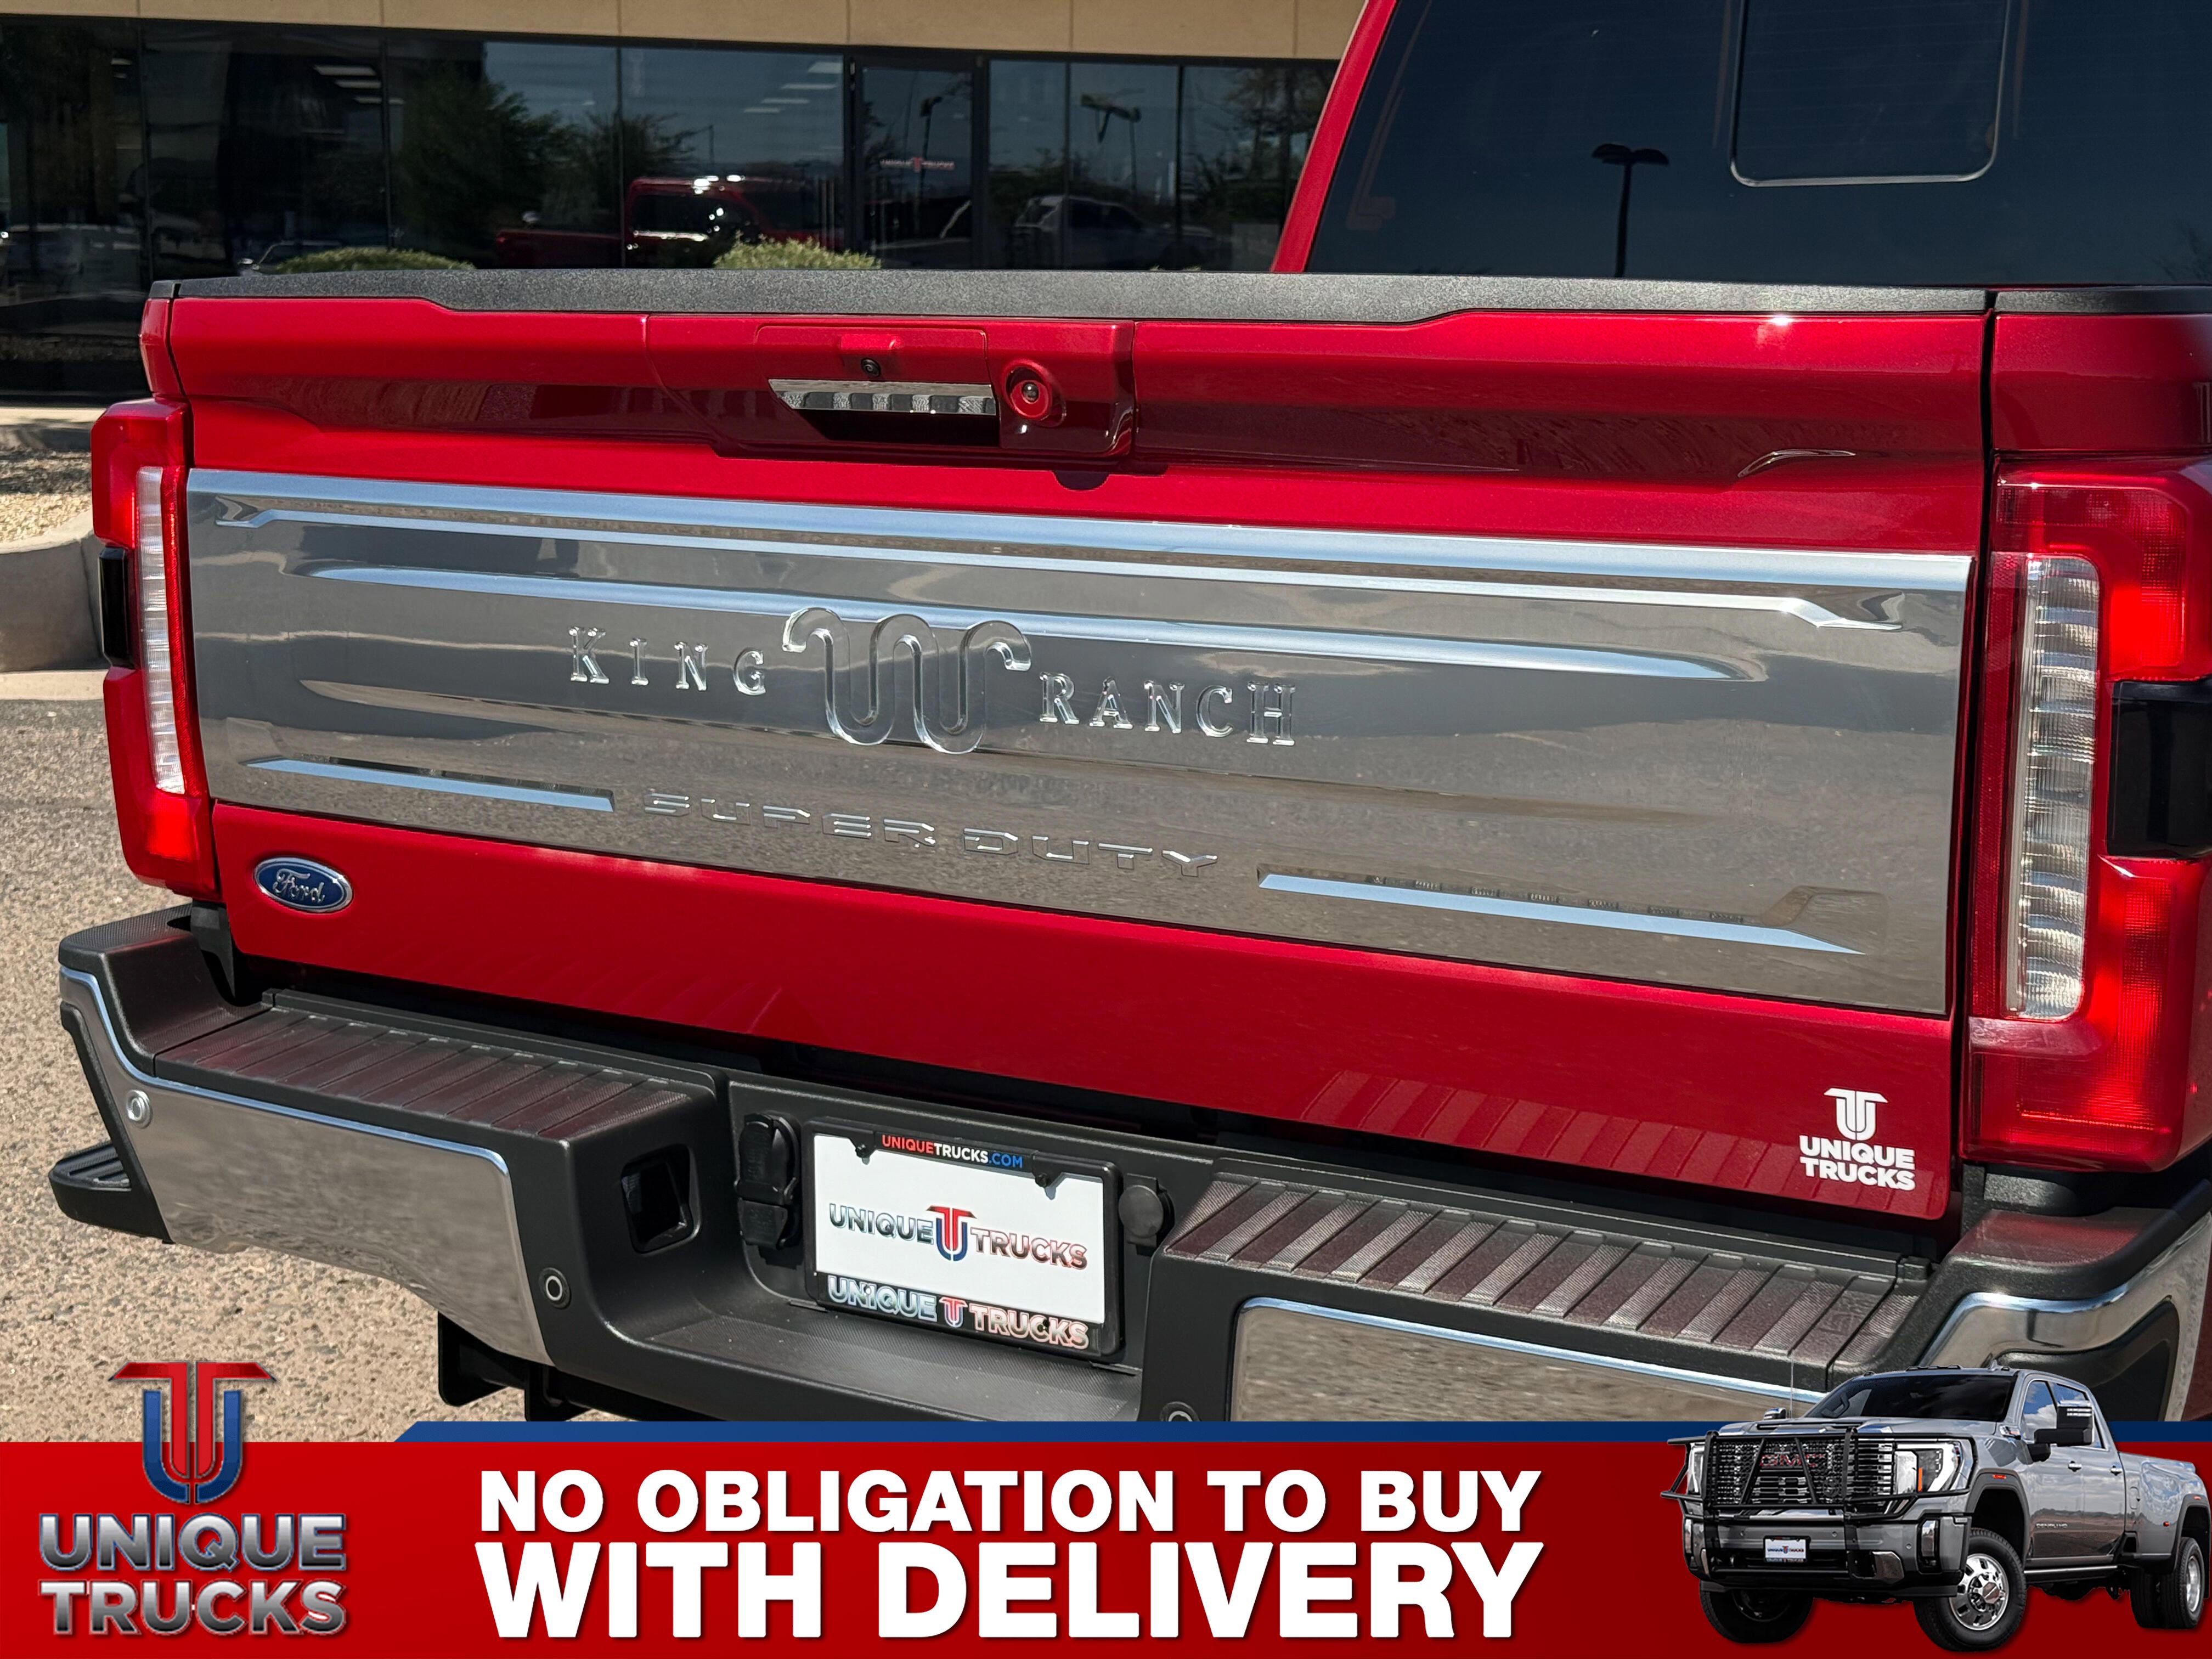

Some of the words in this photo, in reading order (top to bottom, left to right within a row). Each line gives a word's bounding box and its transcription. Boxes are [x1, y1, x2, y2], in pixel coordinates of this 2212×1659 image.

[568, 626, 766, 696] KING
[1040, 672, 1296, 746] RANCH
[644, 792, 936, 847] SUPER
[963, 827, 1218, 877] DUTY
[273, 868, 325, 904] Ford
[882, 1134, 1023, 1169] UNIQUETRUCKS.COM
[1799, 1135, 1915, 1170] UNIQUE
[1799, 1156, 1916, 1191] TRUCKS
[829, 1203, 934, 1245] UNIQUE
[971, 1227, 1088, 1270] TRUCKS
[827, 1275, 938, 1322] UNIQUE
[969, 1303, 1090, 1350] TRUCKS
